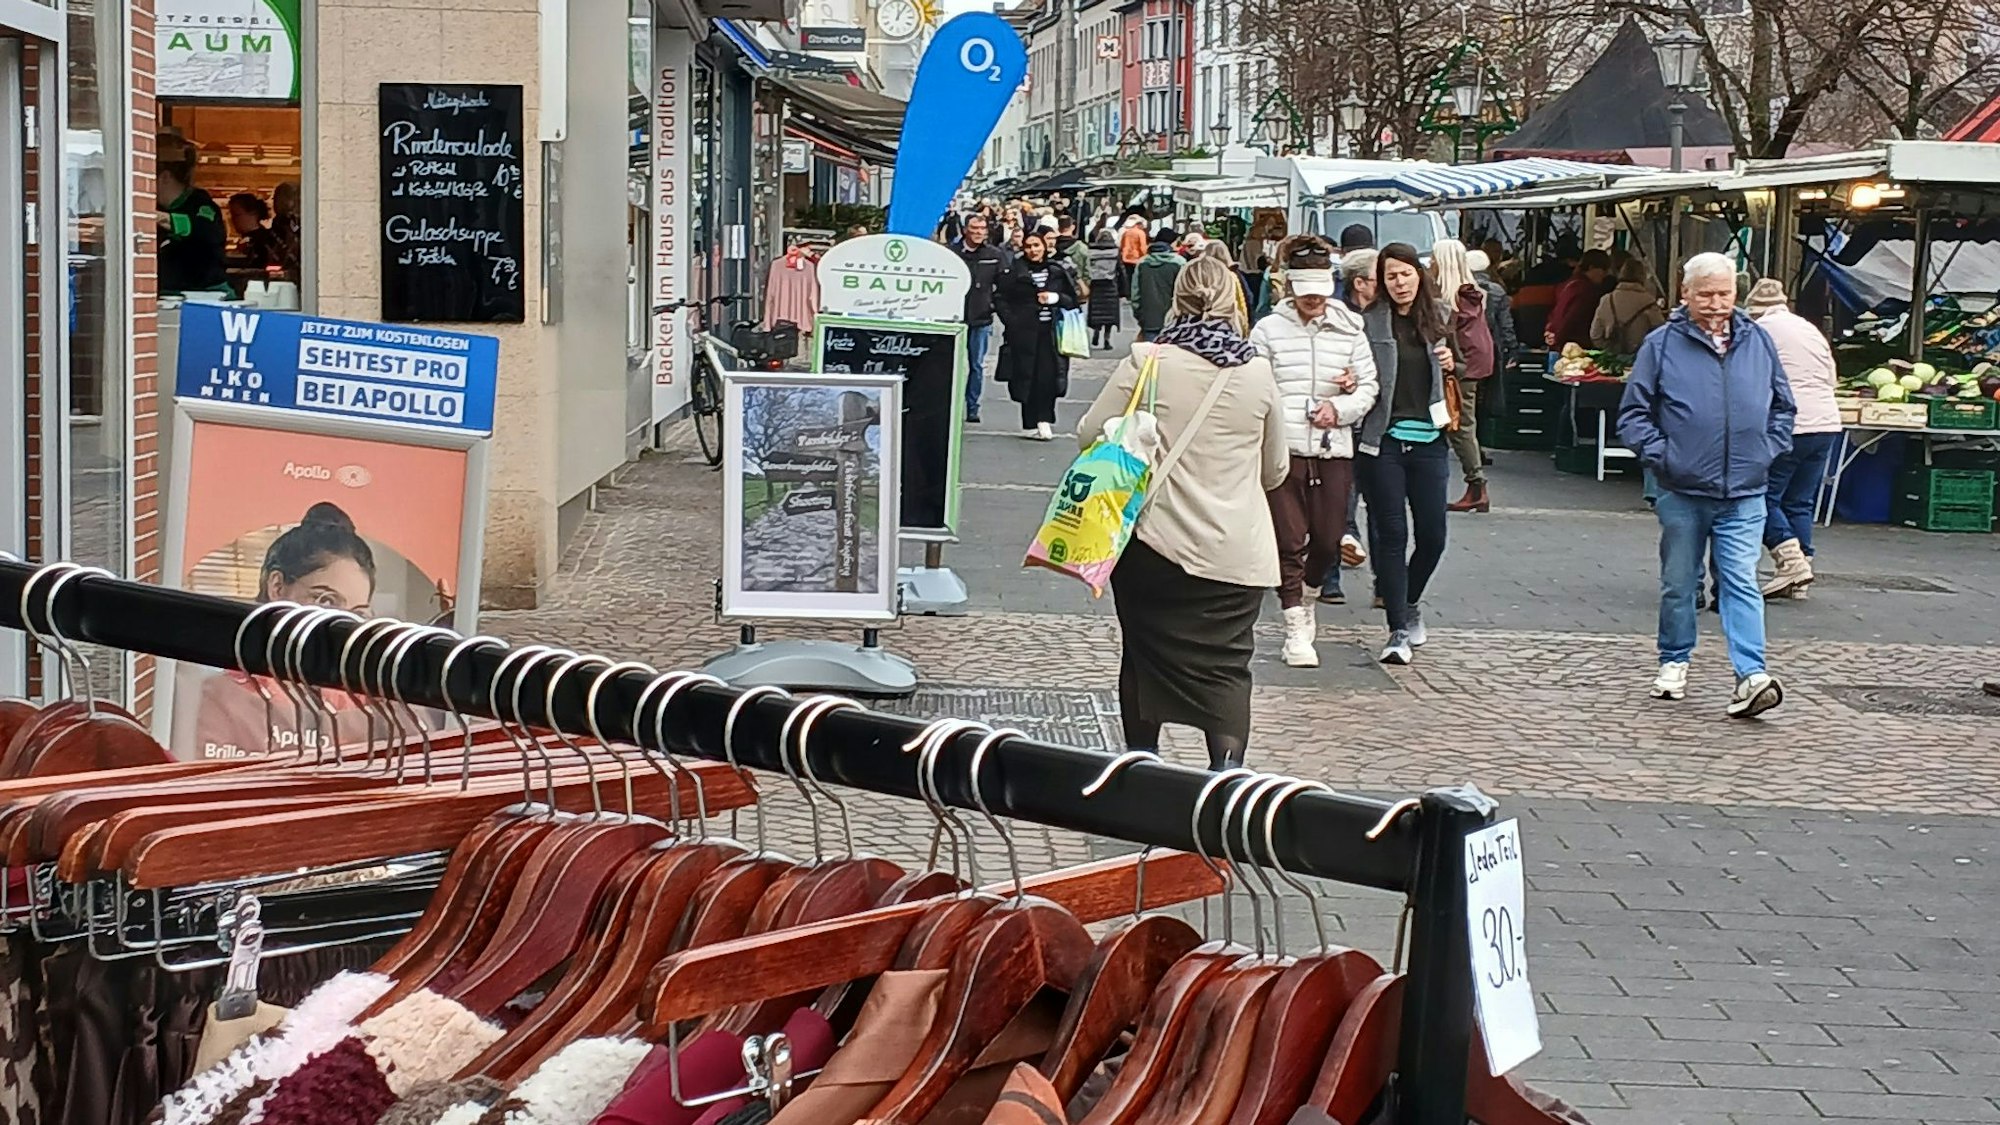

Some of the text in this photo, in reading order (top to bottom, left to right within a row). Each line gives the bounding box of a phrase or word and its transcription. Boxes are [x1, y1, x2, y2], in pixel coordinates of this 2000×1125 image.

[808, 34, 862, 44] Street One
[657, 68, 676, 160] Tradition
[660, 169, 675, 205] aus
[656, 214, 674, 266] Haus
[656, 276, 673, 300] im
[843, 275, 943, 295] BAUM
[301, 321, 470, 350] JETZT ZUM KOSTENLOSEN
[305, 347, 459, 381] SEHTEST PRO
[303, 381, 457, 418] BEI APOLLO
[284, 462, 331, 480] Apollo
[1496, 831, 1518, 863] Teil
